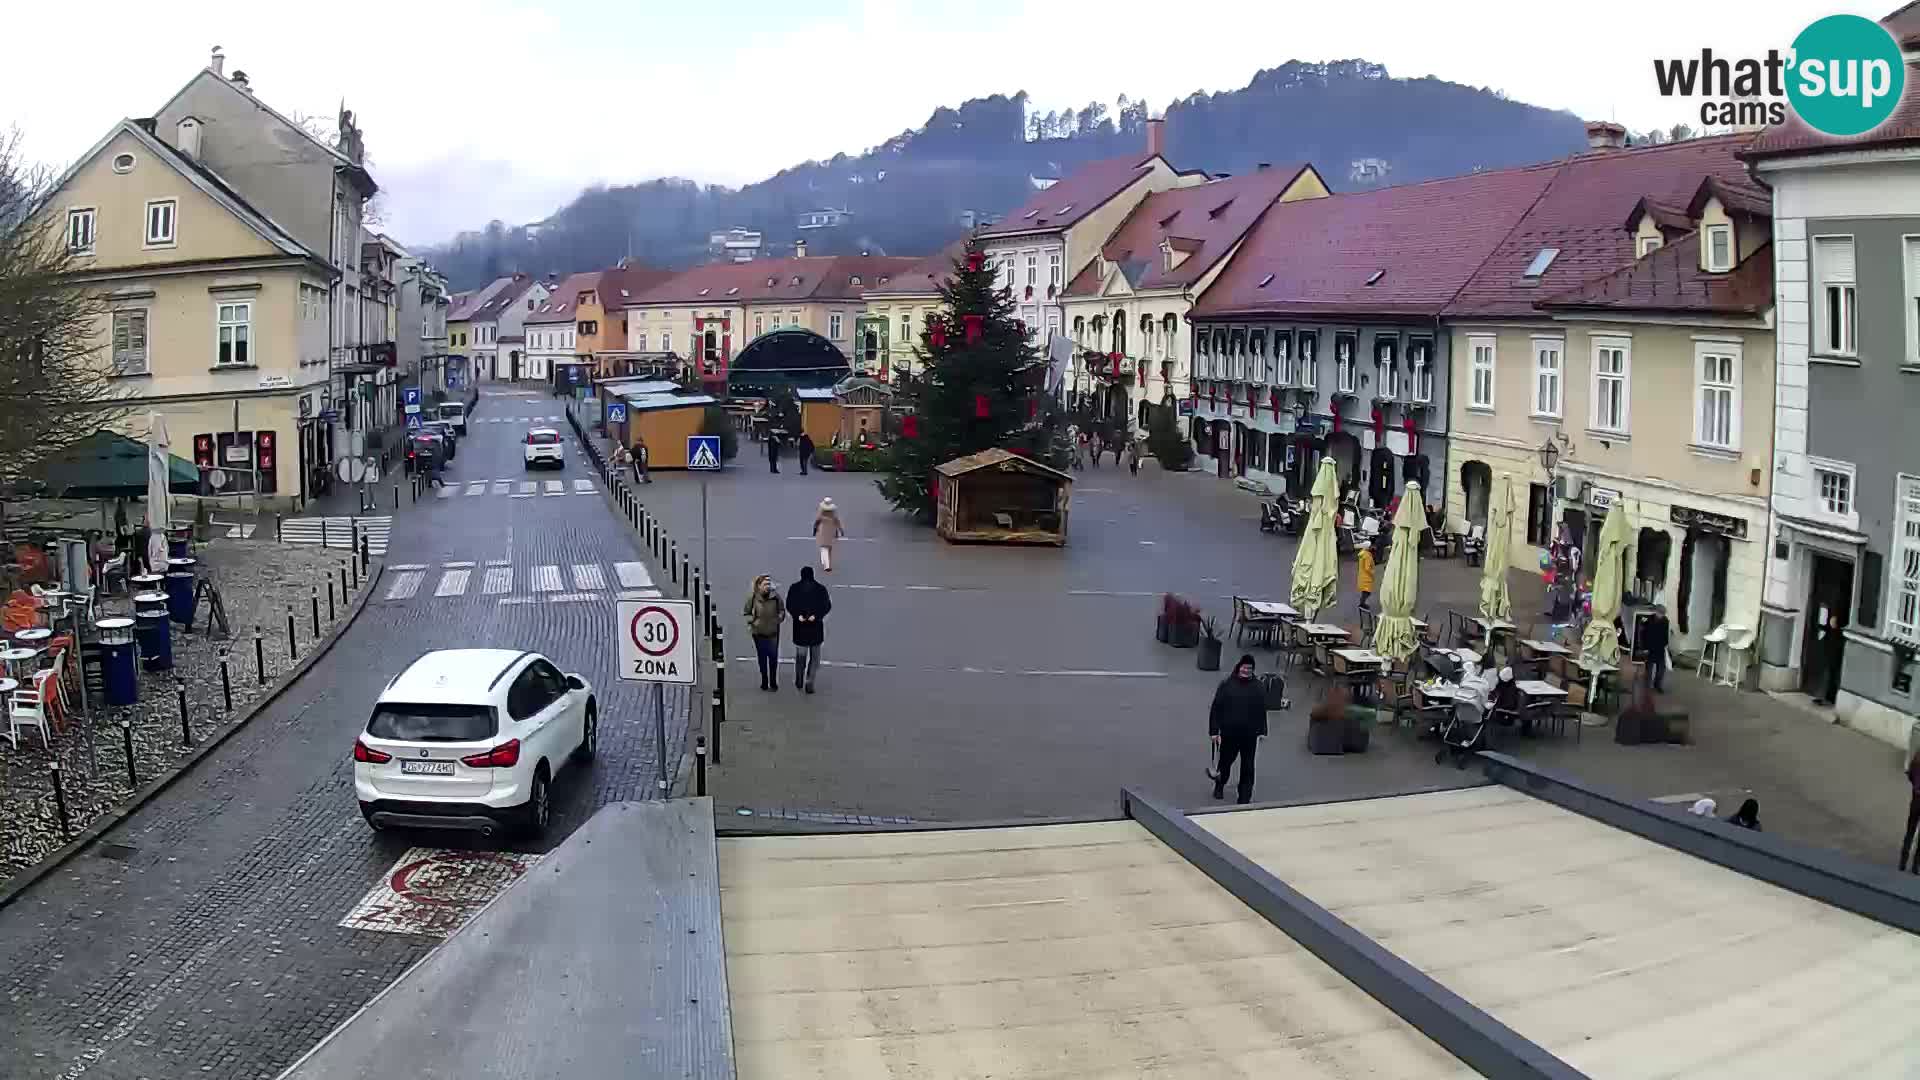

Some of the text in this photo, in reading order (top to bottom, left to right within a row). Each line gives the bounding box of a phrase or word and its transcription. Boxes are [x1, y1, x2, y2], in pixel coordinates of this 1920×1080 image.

[408, 391, 417, 402] P
[644, 622, 667, 643] 30
[633, 659, 678, 676] ZONA
